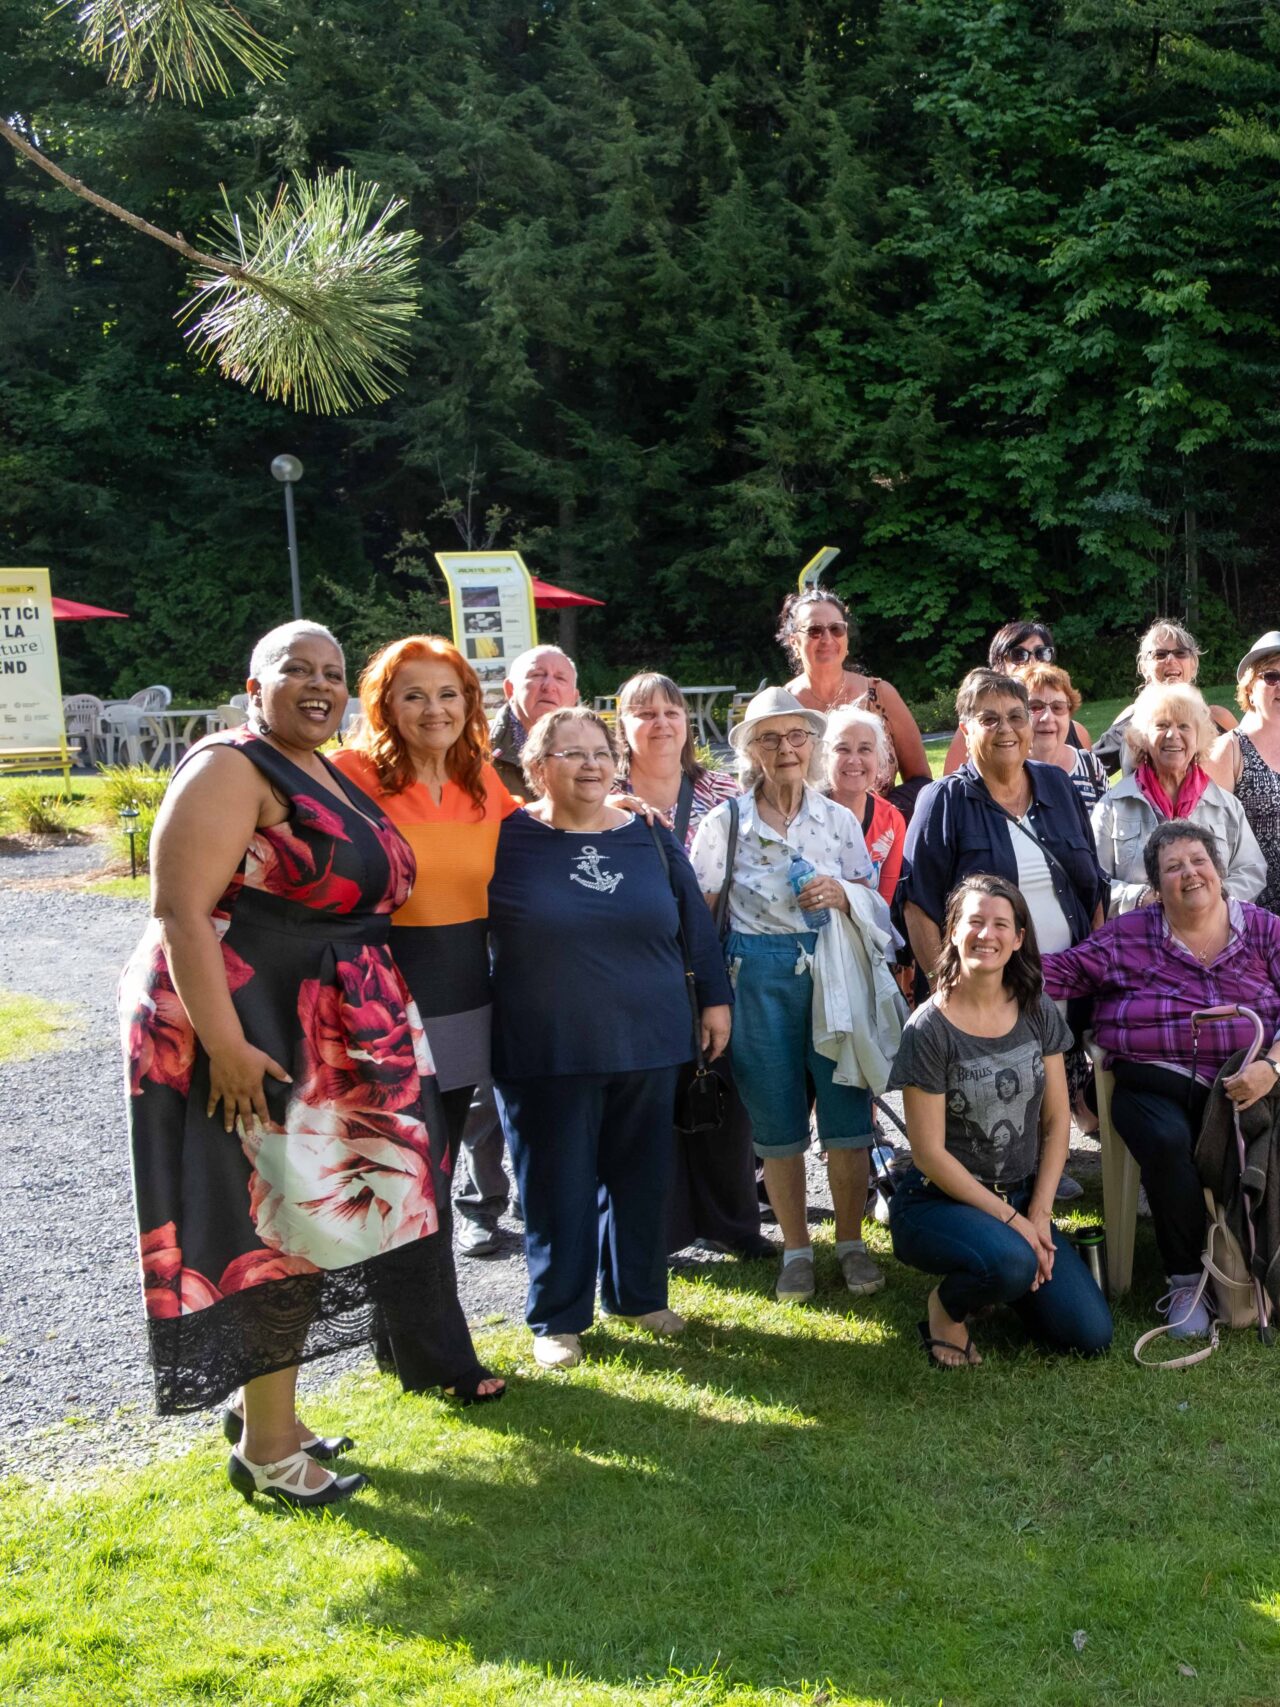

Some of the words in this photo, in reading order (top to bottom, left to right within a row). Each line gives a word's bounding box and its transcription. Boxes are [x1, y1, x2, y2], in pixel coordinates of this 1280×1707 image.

[0, 607, 11, 620] T
[17, 607, 39, 619] ICI
[5, 625, 25, 637] LA
[0, 642, 38, 656] ture
[958, 1066, 993, 1081] BEATLES
